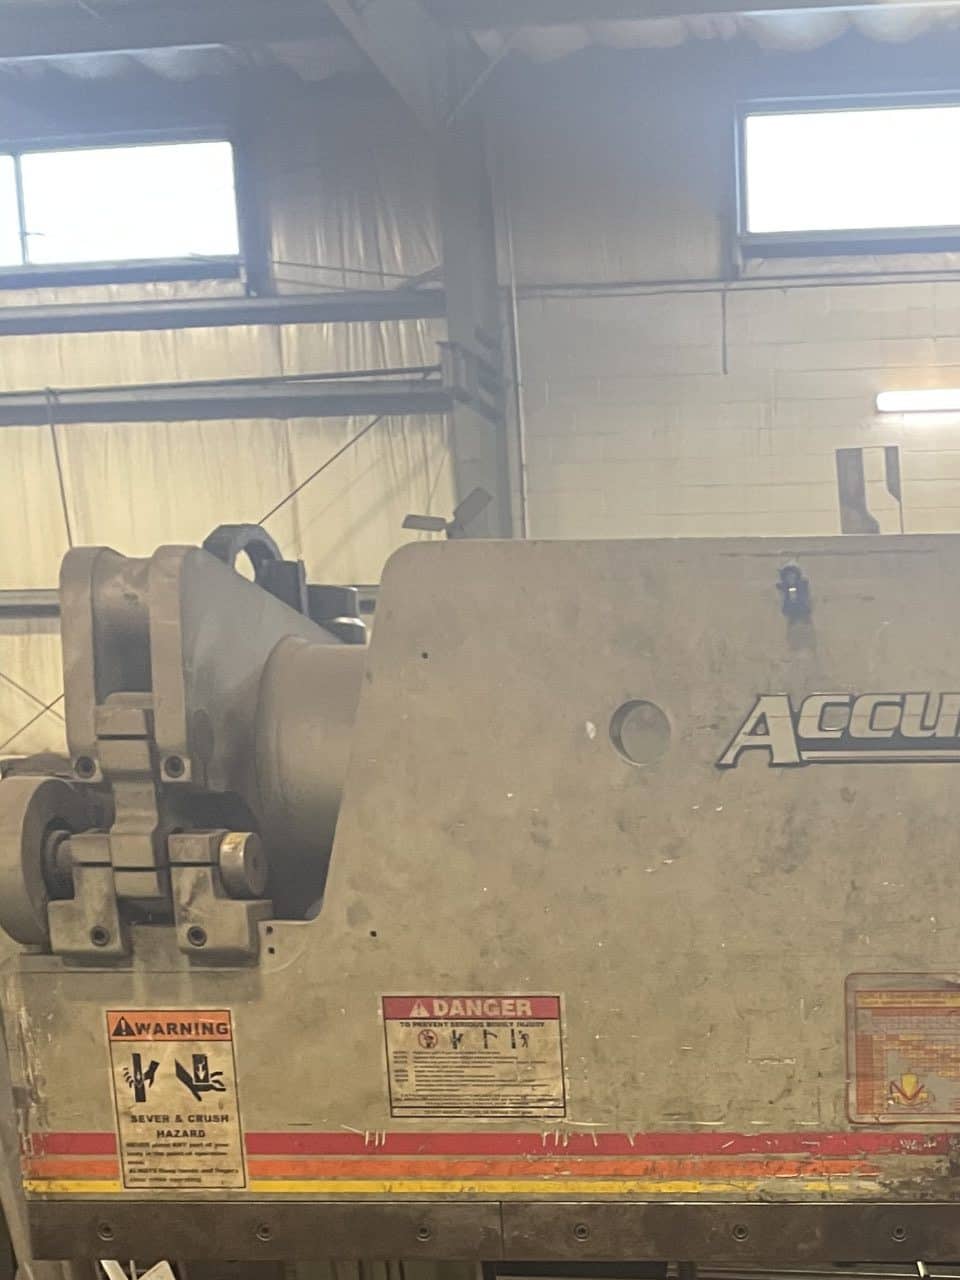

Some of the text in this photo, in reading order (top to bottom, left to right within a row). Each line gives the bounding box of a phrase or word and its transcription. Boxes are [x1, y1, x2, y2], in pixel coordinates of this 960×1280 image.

[432, 998, 533, 1018] DANGER
[135, 1022, 229, 1037] WARNING
[130, 1113, 229, 1123] SEVER & CRUSH
[156, 1129, 206, 1139] HAZARD
